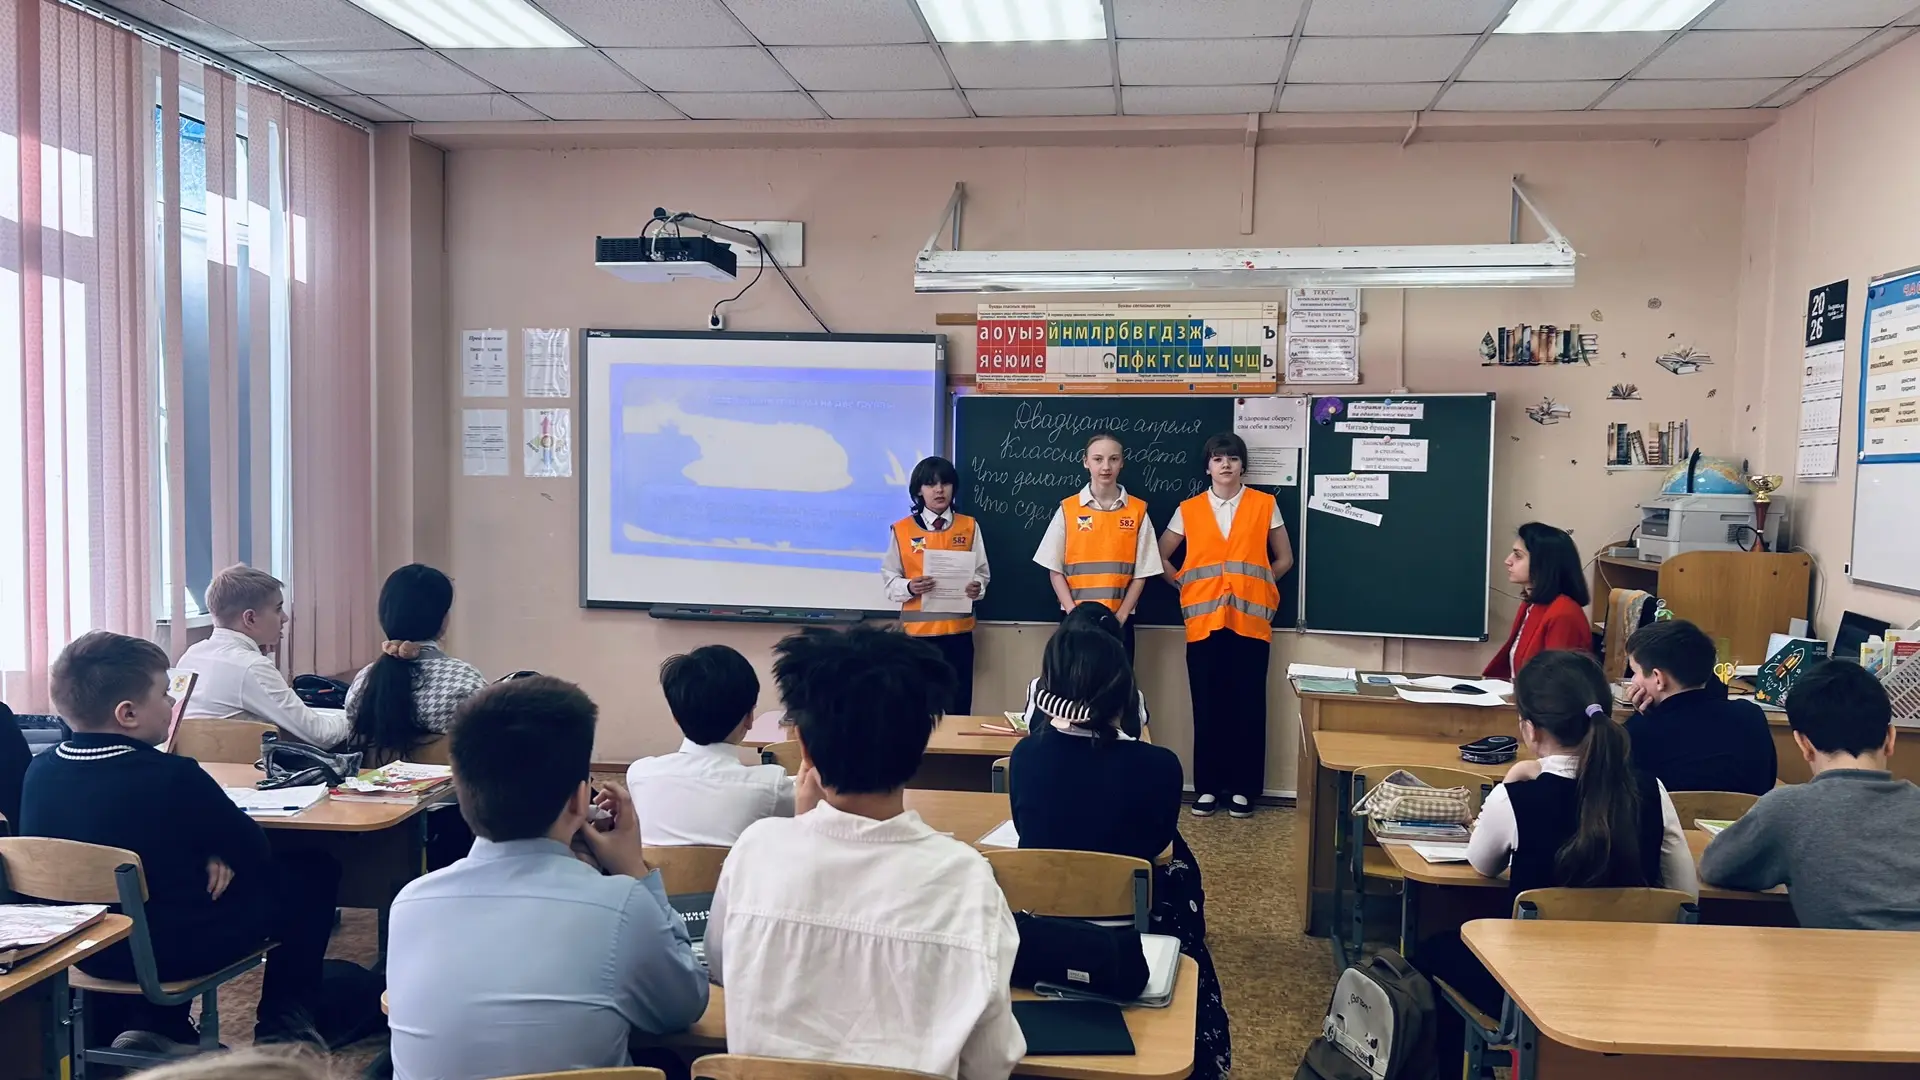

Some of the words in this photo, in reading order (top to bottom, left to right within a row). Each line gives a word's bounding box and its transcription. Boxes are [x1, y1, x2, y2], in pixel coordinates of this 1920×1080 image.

[1811, 291, 1825, 316] 20
[1810, 316, 1823, 341] 26
[1014, 400, 1131, 443] Двадцатое
[1133, 418, 1203, 442] апреля
[971, 456, 1008, 485] Что
[1011, 470, 1082, 496] делать
[1142, 464, 1182, 492] Что
[973, 484, 1008, 512] Что
[1014, 500, 1053, 529] сдел
[1119, 519, 1135, 527] 582
[952, 536, 966, 544] 582
